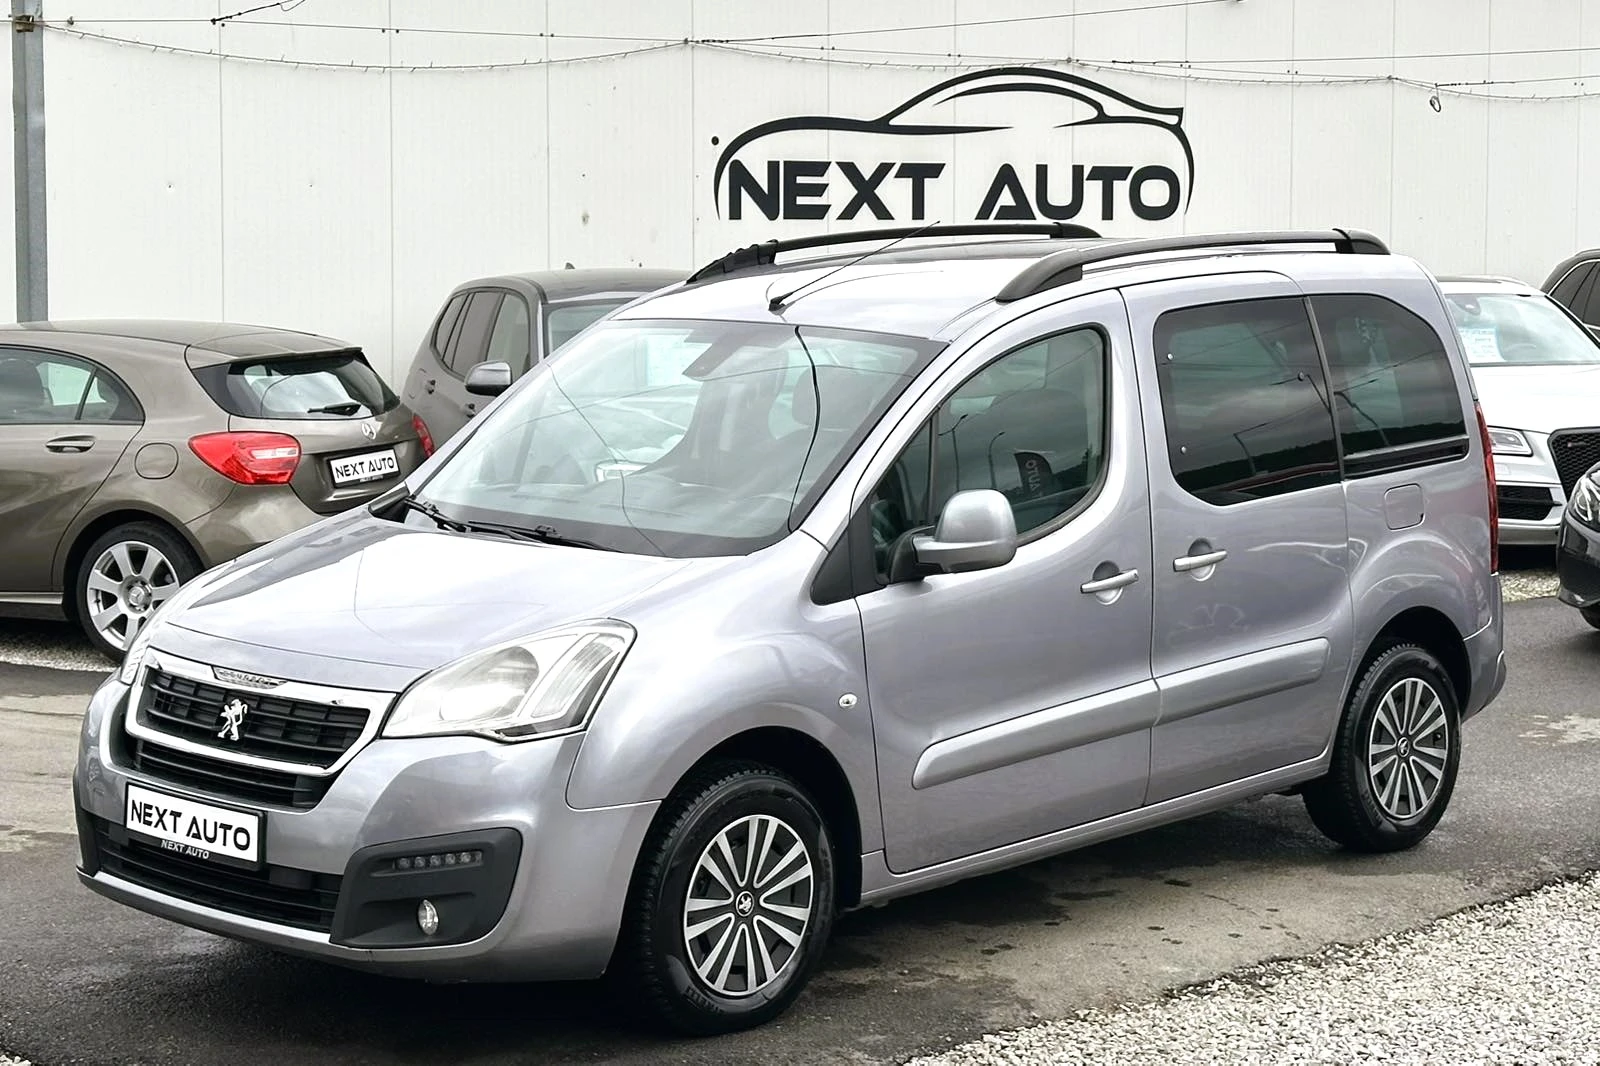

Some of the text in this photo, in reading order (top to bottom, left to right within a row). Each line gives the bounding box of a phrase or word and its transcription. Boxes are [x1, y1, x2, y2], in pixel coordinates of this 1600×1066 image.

[728, 159, 1181, 221] NEXT AUTO
[335, 461, 365, 479] NEXT
[368, 457, 395, 472] AUTO
[131, 799, 251, 851] NEXT AUTO
[161, 839, 210, 860] NEXT AUTO
